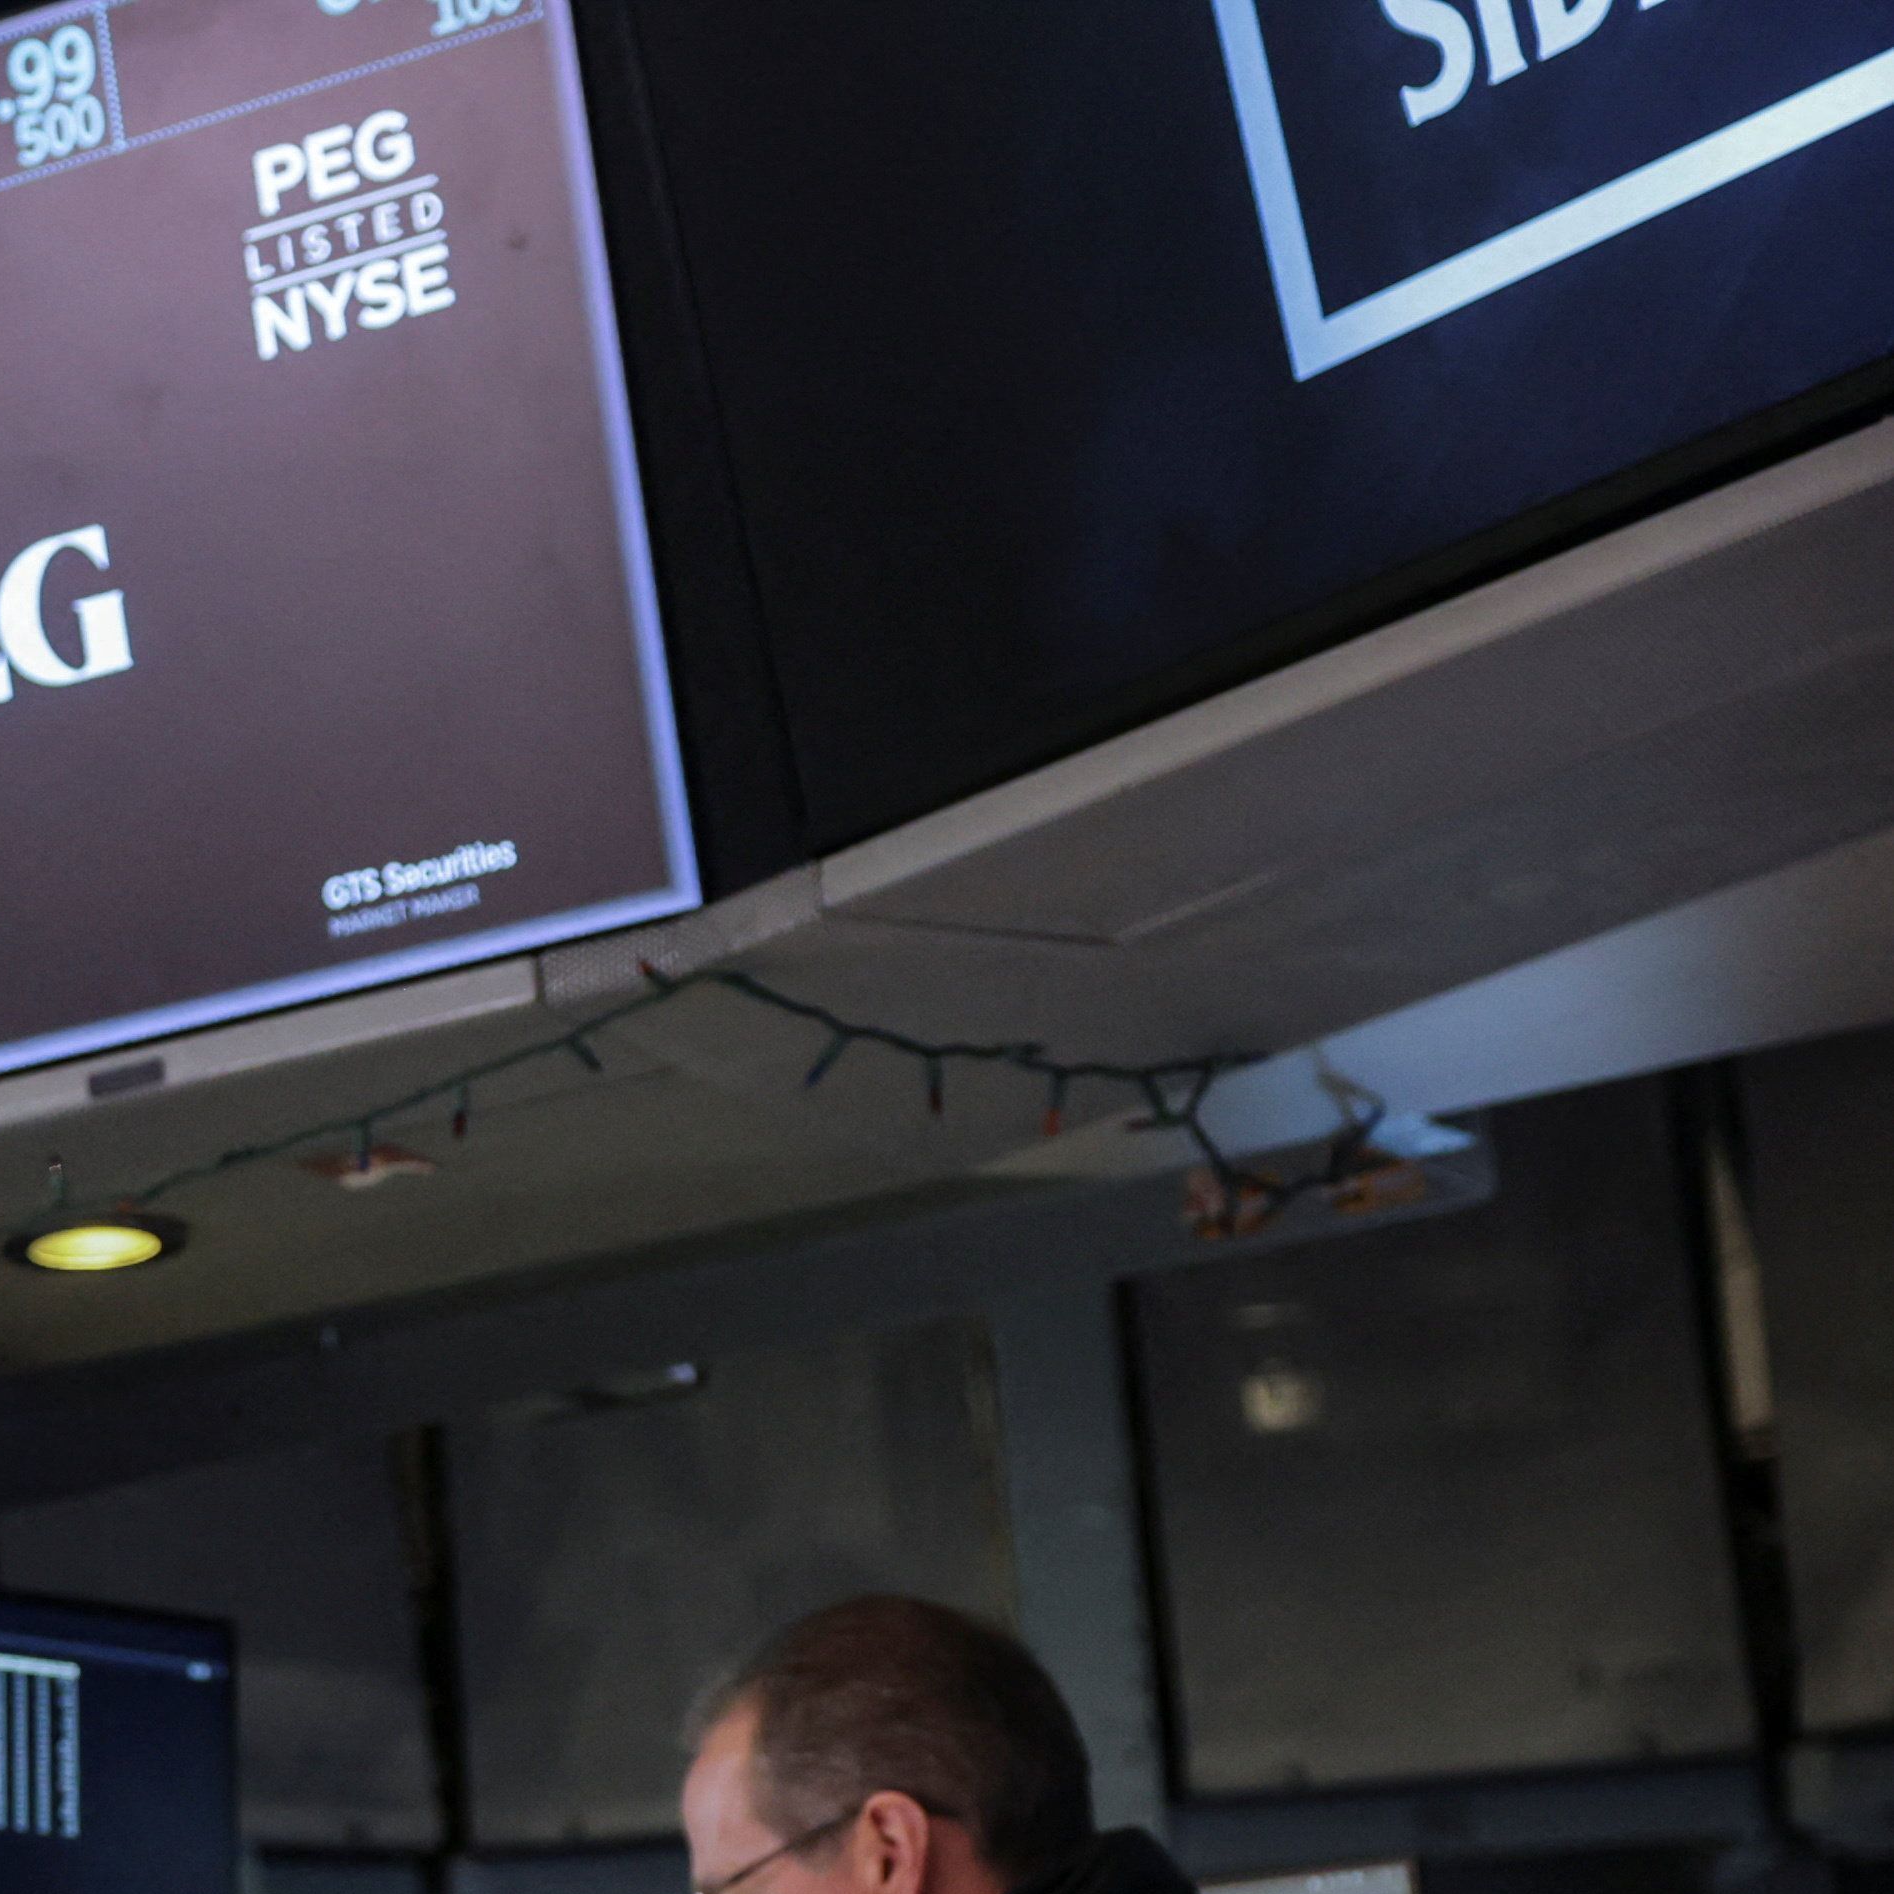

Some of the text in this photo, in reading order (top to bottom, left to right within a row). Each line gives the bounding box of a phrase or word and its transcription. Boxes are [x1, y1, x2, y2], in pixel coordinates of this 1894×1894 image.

[17, 95, 106, 166] 500
[253, 109, 415, 217] PEG
[243, 193, 444, 283] LISTED
[251, 242, 456, 361] NYSE
[321, 839, 518, 911] GTS Securities
